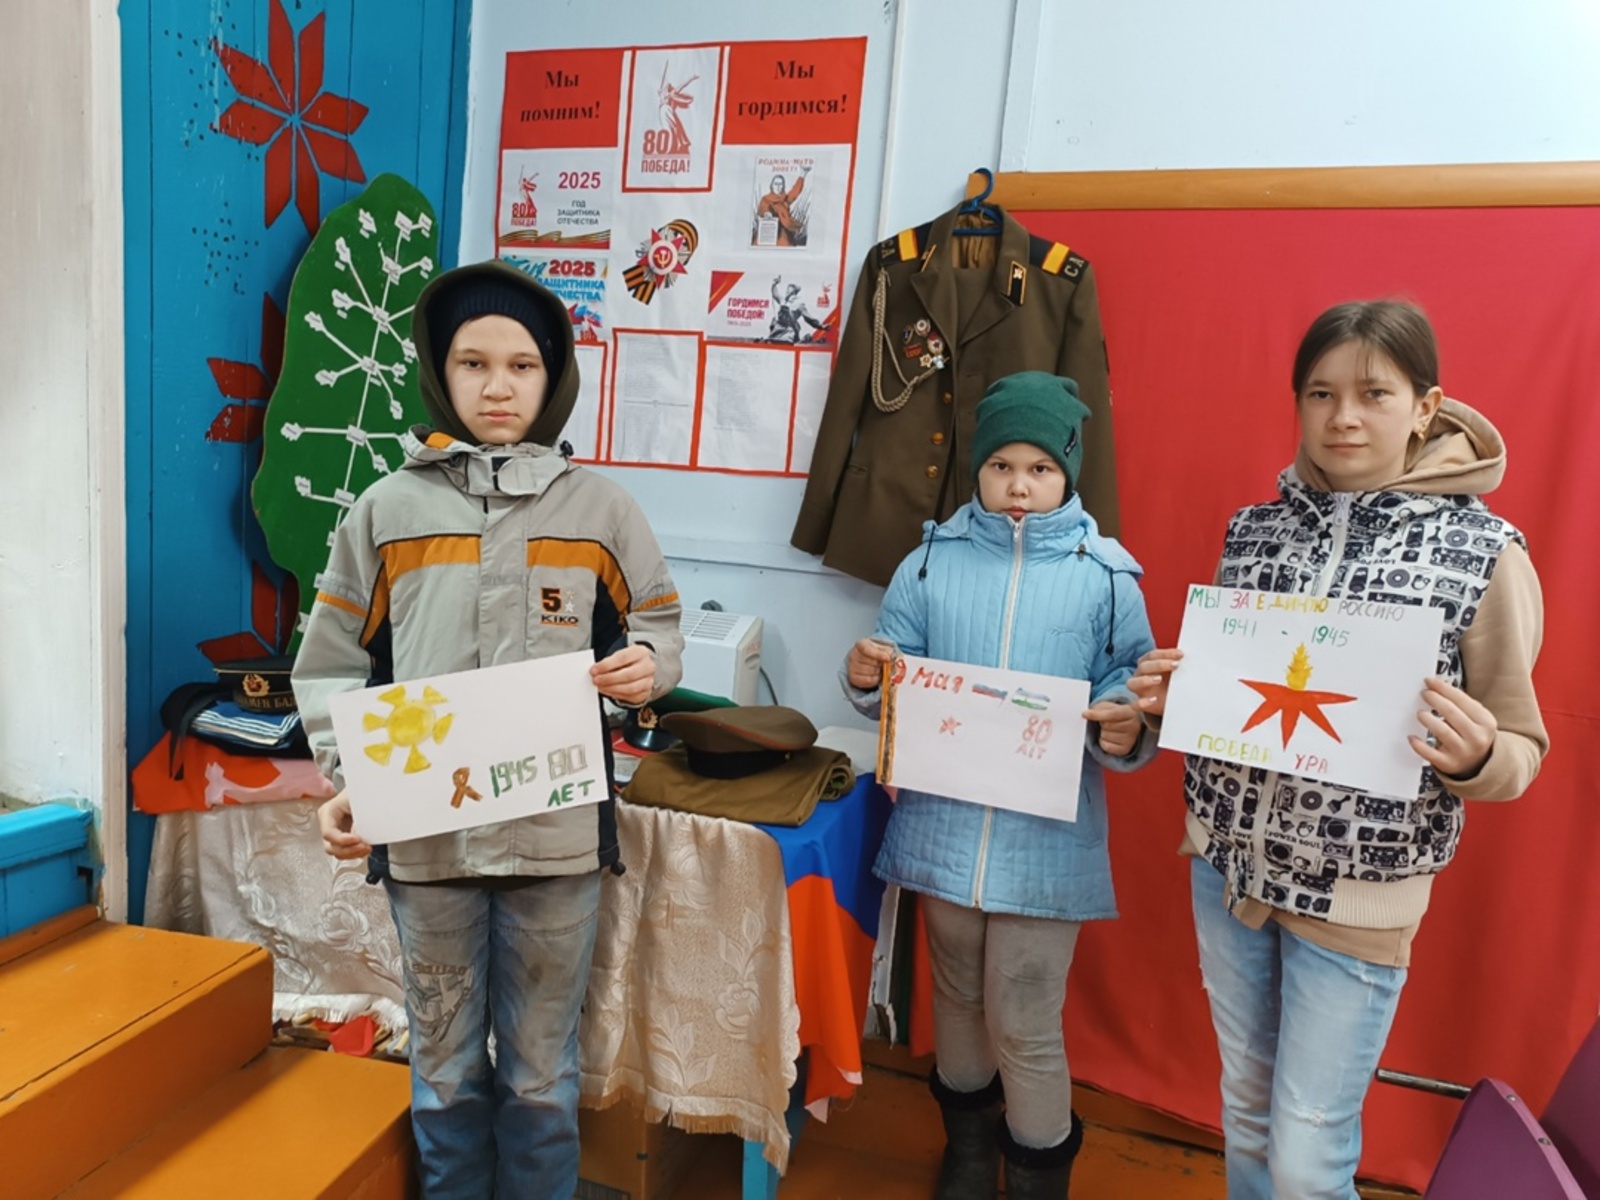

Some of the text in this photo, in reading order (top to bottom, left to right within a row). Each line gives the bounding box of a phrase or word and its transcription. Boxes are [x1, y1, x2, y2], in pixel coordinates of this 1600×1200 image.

[545, 70, 579, 88] Мы
[775, 60, 815, 80] Мы
[520, 100, 600, 122] помним!
[738, 94, 847, 121] гордимся!
[642, 129, 670, 155] 80
[641, 159, 690, 175] ПОБЕДА!
[558, 171, 601, 189] 2025
[557, 208, 600, 217] ЗАЩИТНИКА
[571, 199, 586, 208] ГОД
[557, 217, 599, 225] ОТЕЧЕСТВА
[548, 259, 596, 277] 2025
[541, 587, 562, 612] 5
[1189, 586, 1221, 610] МЫ
[1230, 591, 1250, 611] ЗА
[1338, 600, 1405, 622] РОССИЮ
[541, 614, 579, 624] KIKO
[1222, 617, 1257, 638] 1941
[1311, 625, 1350, 647] 1945
[1022, 714, 1053, 744] 80
[489, 743, 588, 798] 1945 80
[1294, 753, 1328, 774] УРА
[547, 779, 596, 807] ЛЕТ
